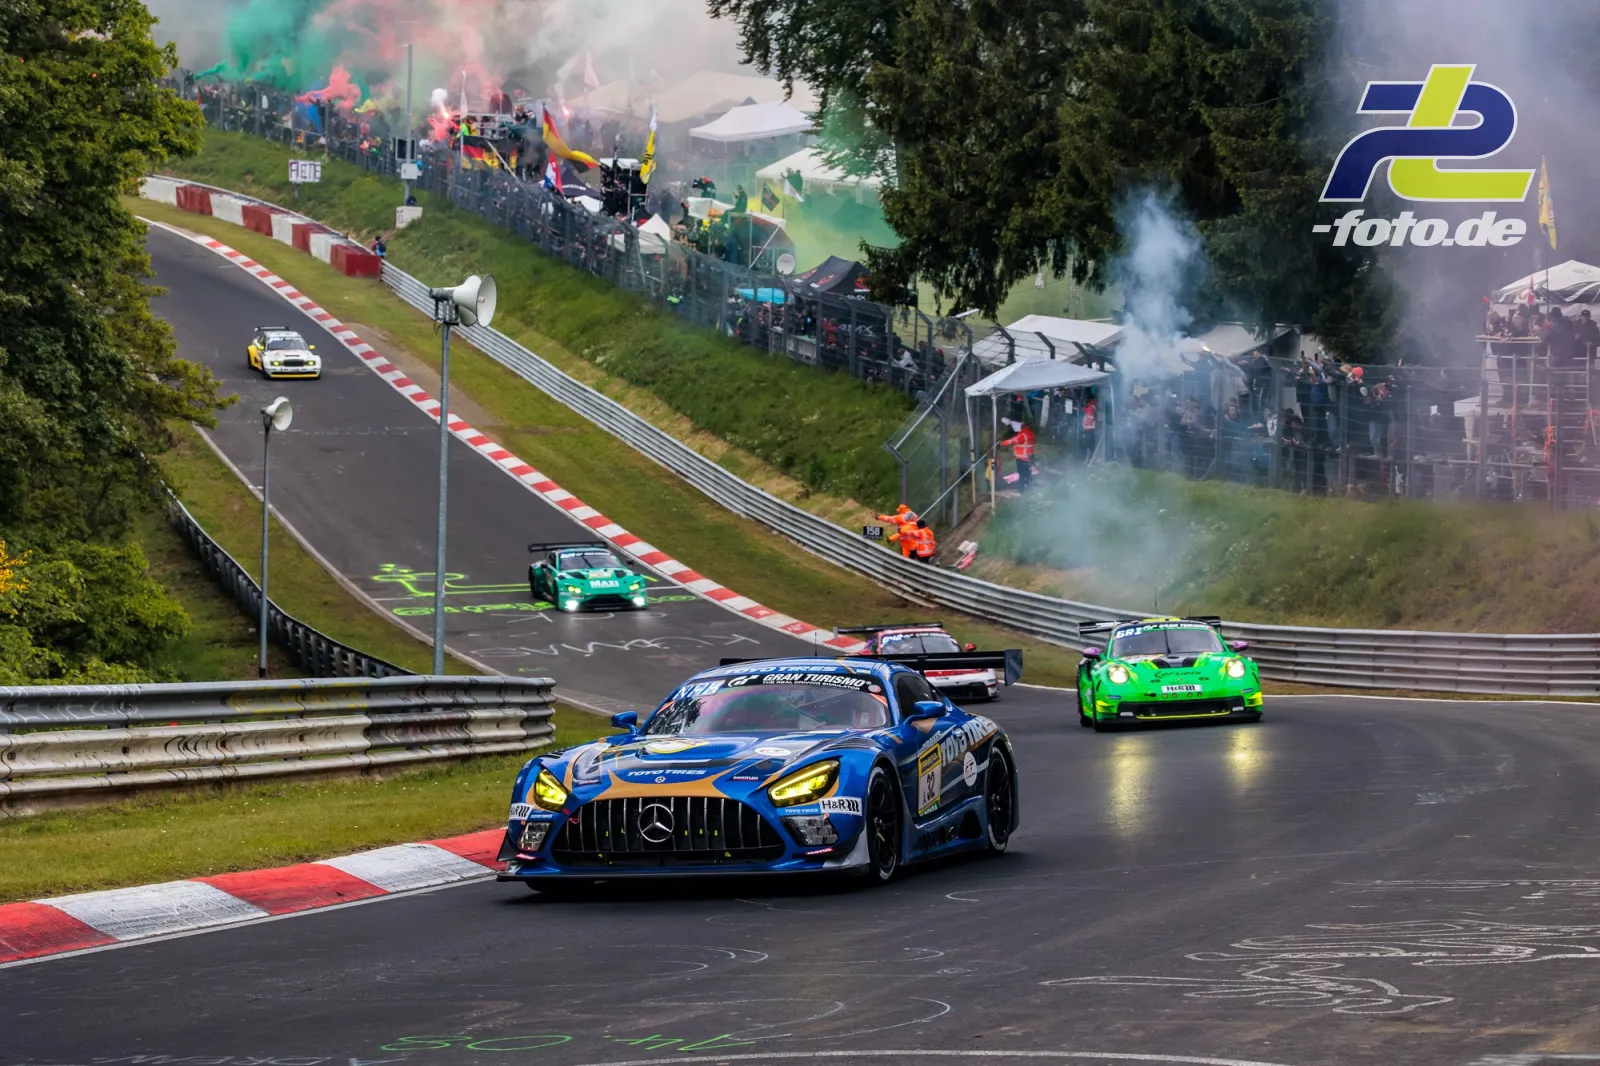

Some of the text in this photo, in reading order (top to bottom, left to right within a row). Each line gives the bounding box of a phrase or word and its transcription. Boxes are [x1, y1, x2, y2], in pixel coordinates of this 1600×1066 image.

[866, 526, 881, 536] 158
[778, 665, 839, 673] TIRES
[763, 673, 805, 682] GRAN
[627, 769, 664, 777] TOYO
[821, 799, 846, 811] H&R
